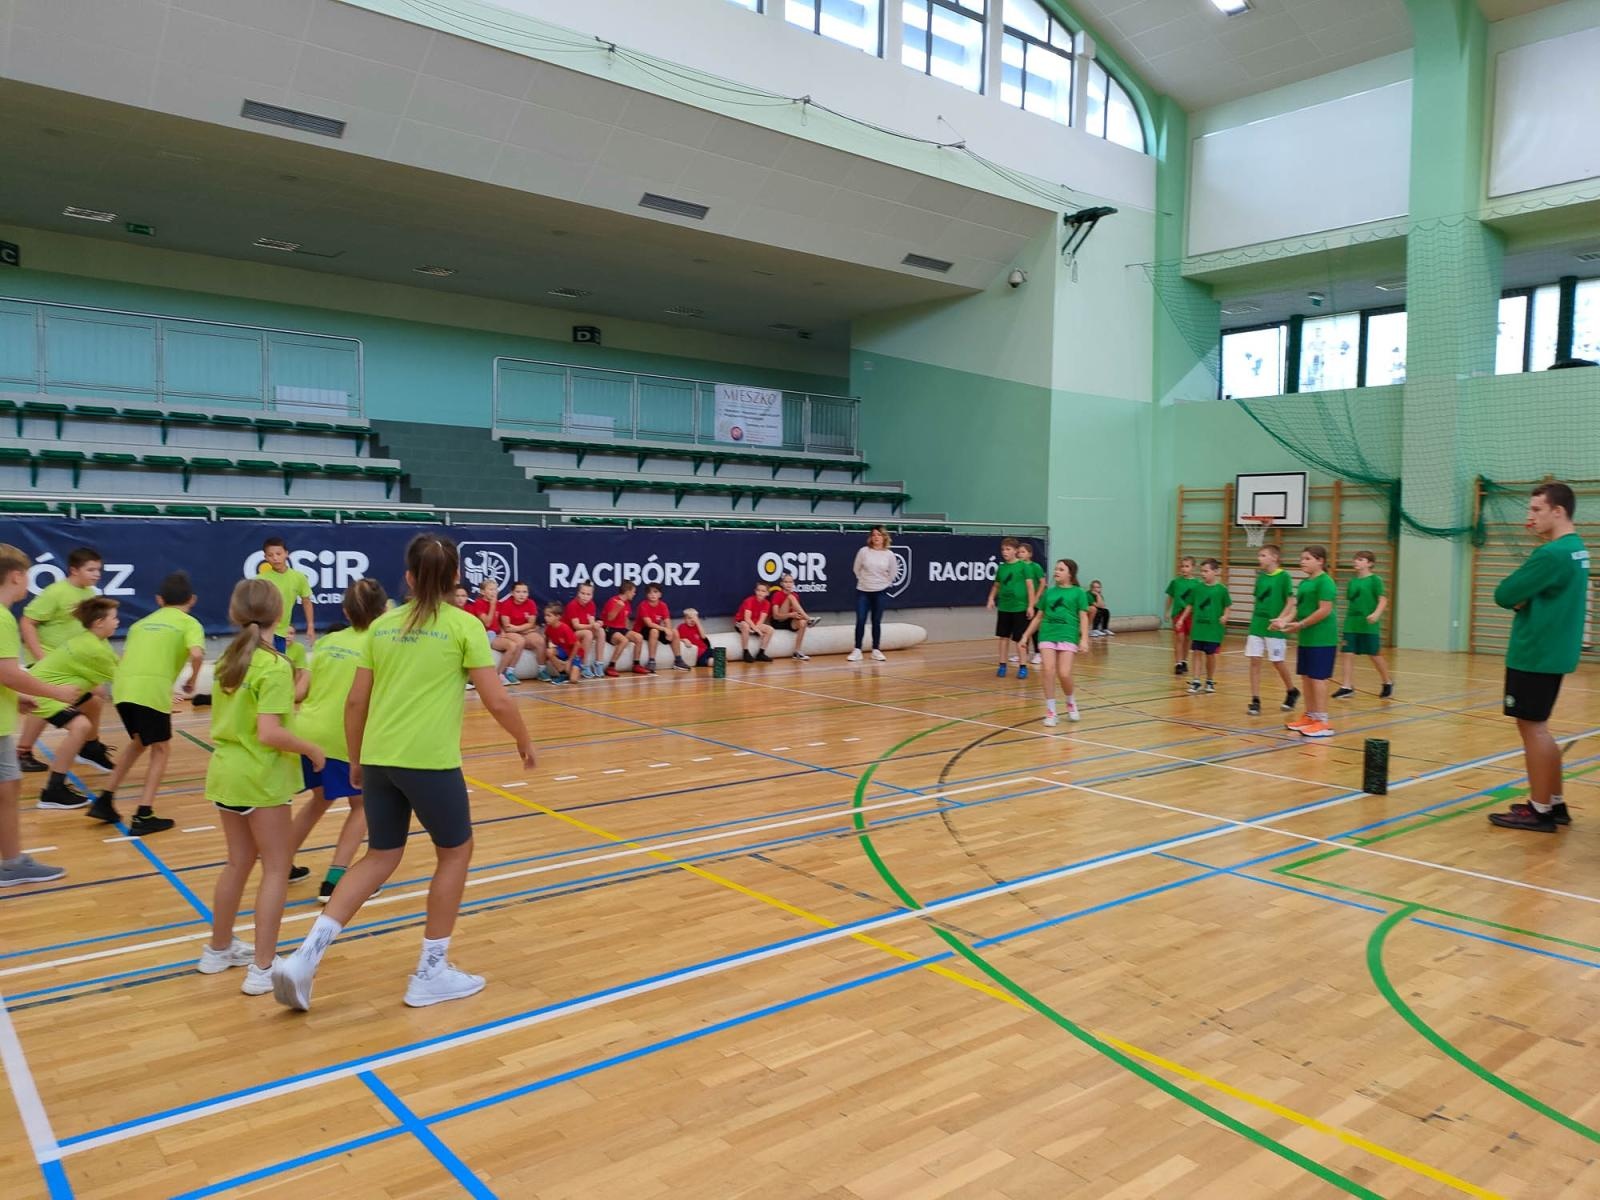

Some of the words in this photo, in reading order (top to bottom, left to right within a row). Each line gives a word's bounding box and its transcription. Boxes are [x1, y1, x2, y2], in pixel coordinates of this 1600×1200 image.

[1, 249, 17, 262] C
[577, 331, 591, 341] D
[723, 389, 777, 406] MIESZKO
[549, 554, 701, 588] RACIBÓRZ
[757, 551, 828, 582] OSiR
[929, 556, 1004, 581] RACIBÓ
